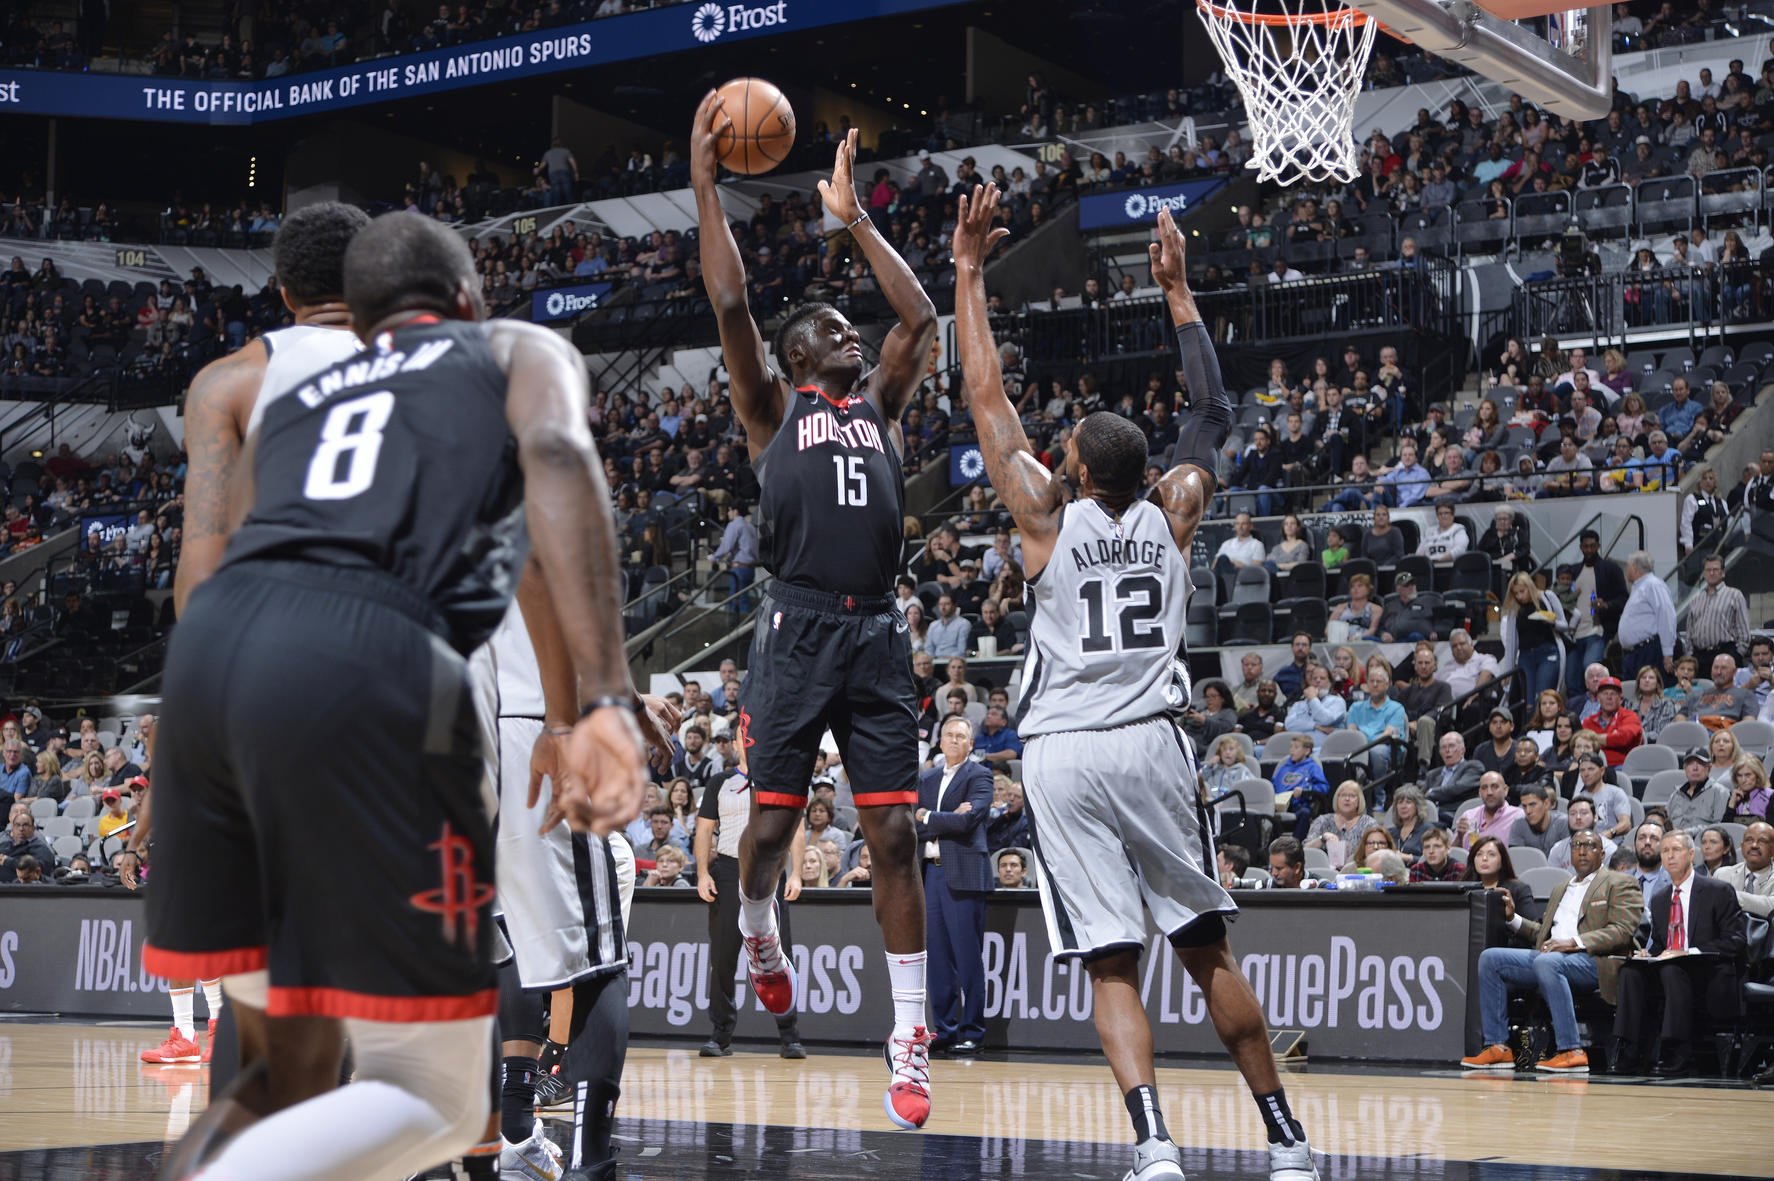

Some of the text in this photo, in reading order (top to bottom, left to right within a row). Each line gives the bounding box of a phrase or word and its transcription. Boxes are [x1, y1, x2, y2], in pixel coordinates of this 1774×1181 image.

[727, 0, 787, 32] Frost
[143, 33, 592, 112] THE OFFICIAL BANK OF THE SAN ANTONIO SPURS
[513, 217, 536, 234] 105
[117, 250, 145, 267] 104
[298, 351, 406, 409] ENNIS
[304, 390, 396, 500] 8
[833, 455, 867, 507] 15
[1077, 573, 1169, 656] 12
